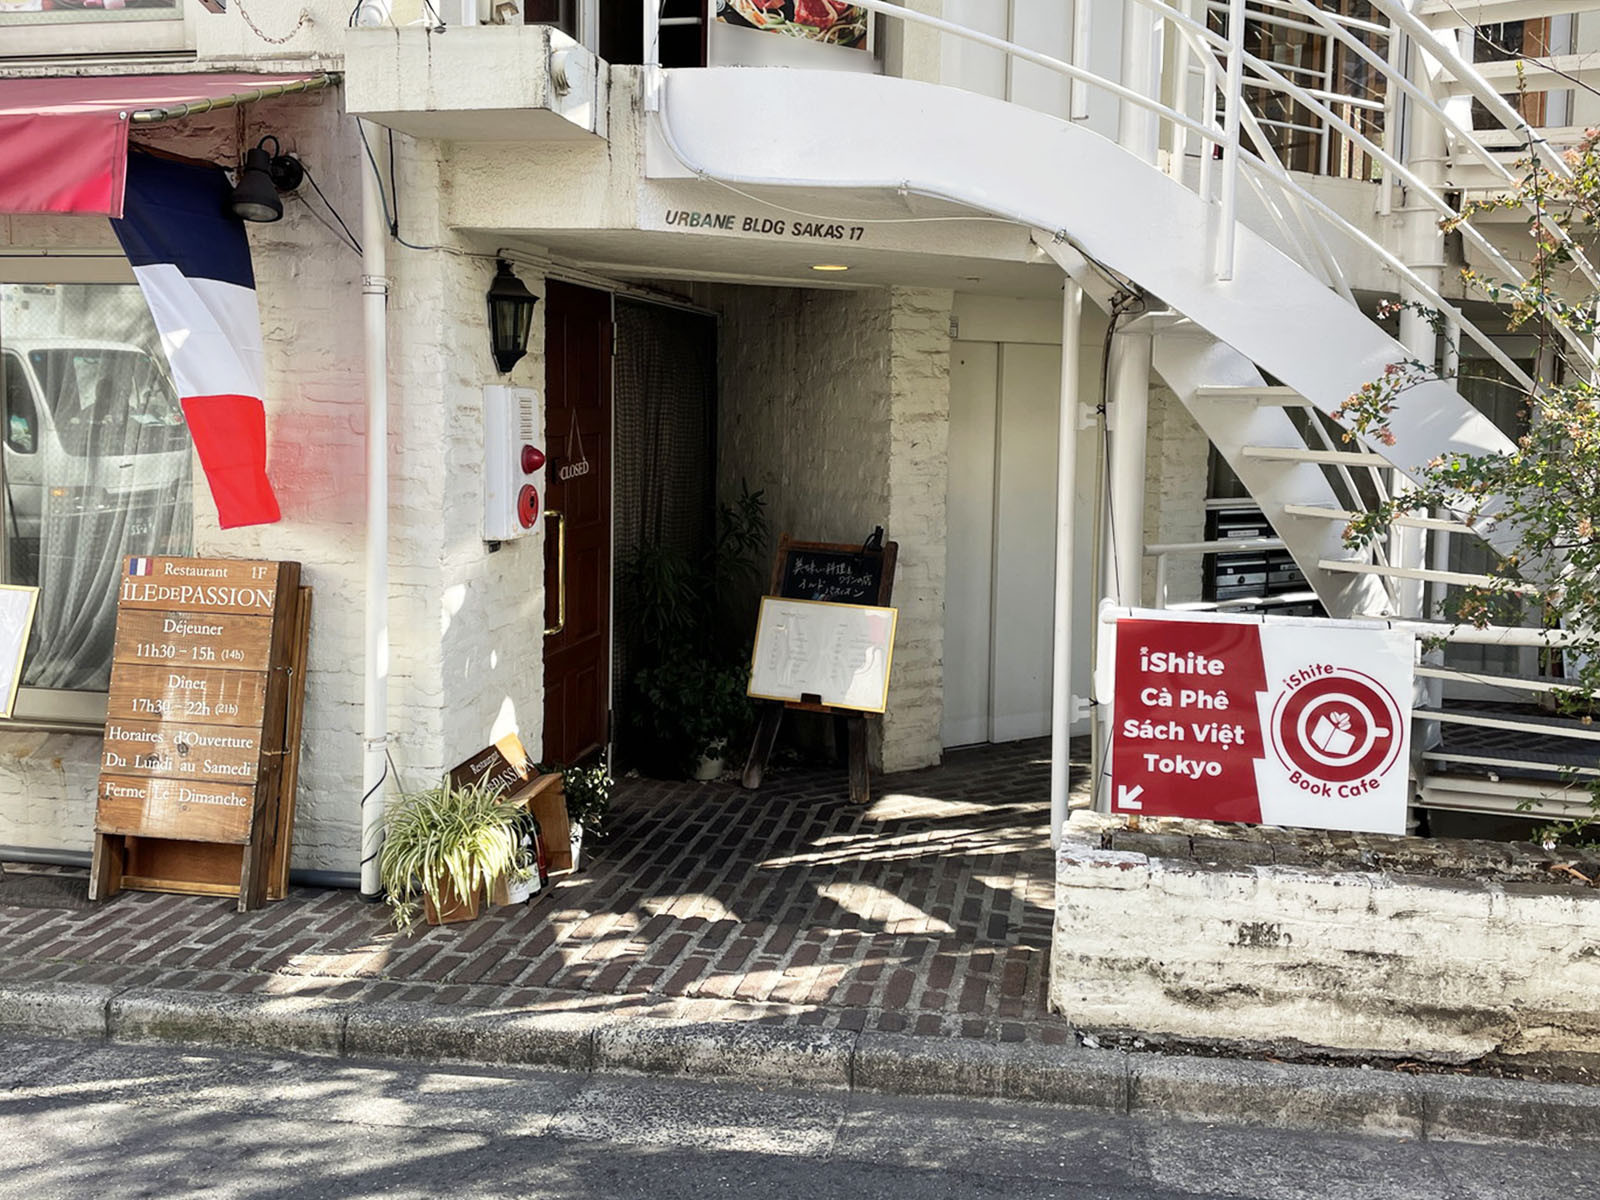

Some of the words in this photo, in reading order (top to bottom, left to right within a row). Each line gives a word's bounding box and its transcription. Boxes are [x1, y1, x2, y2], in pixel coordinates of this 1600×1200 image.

[665, 210, 736, 230] URBANE
[742, 217, 785, 235] BLDG
[791, 222, 845, 239] SAKAS
[848, 227, 864, 241] 17
[560, 460, 590, 480] CLOSED
[164, 562, 228, 578] Restaurant
[251, 566, 267, 579] 1F
[163, 619, 223, 636] Déjeuner
[136, 643, 176, 659] 11h30
[192, 646, 215, 660] 15h
[1140, 646, 1225, 675] iShite
[168, 674, 206, 689] Dîner
[1282, 663, 1334, 691] iShite
[131, 698, 171, 713] 17h30
[186, 701, 210, 716] 22h
[1140, 687, 1172, 707] Cà
[1180, 689, 1229, 710] Phê
[109, 727, 164, 743] Horaires
[1122, 719, 1185, 741] Sách
[1192, 722, 1245, 751] Việt
[105, 753, 126, 767] Du
[135, 755, 173, 771] Lundi
[180, 763, 195, 772] au
[203, 759, 251, 776] Samedi
[1143, 753, 1222, 780] Tokyo
[105, 782, 146, 799] Ferme
[154, 783, 170, 800] Le
[179, 787, 247, 807] Dimanche
[1289, 770, 1331, 798] Book
[1337, 778, 1381, 798] Cafe
